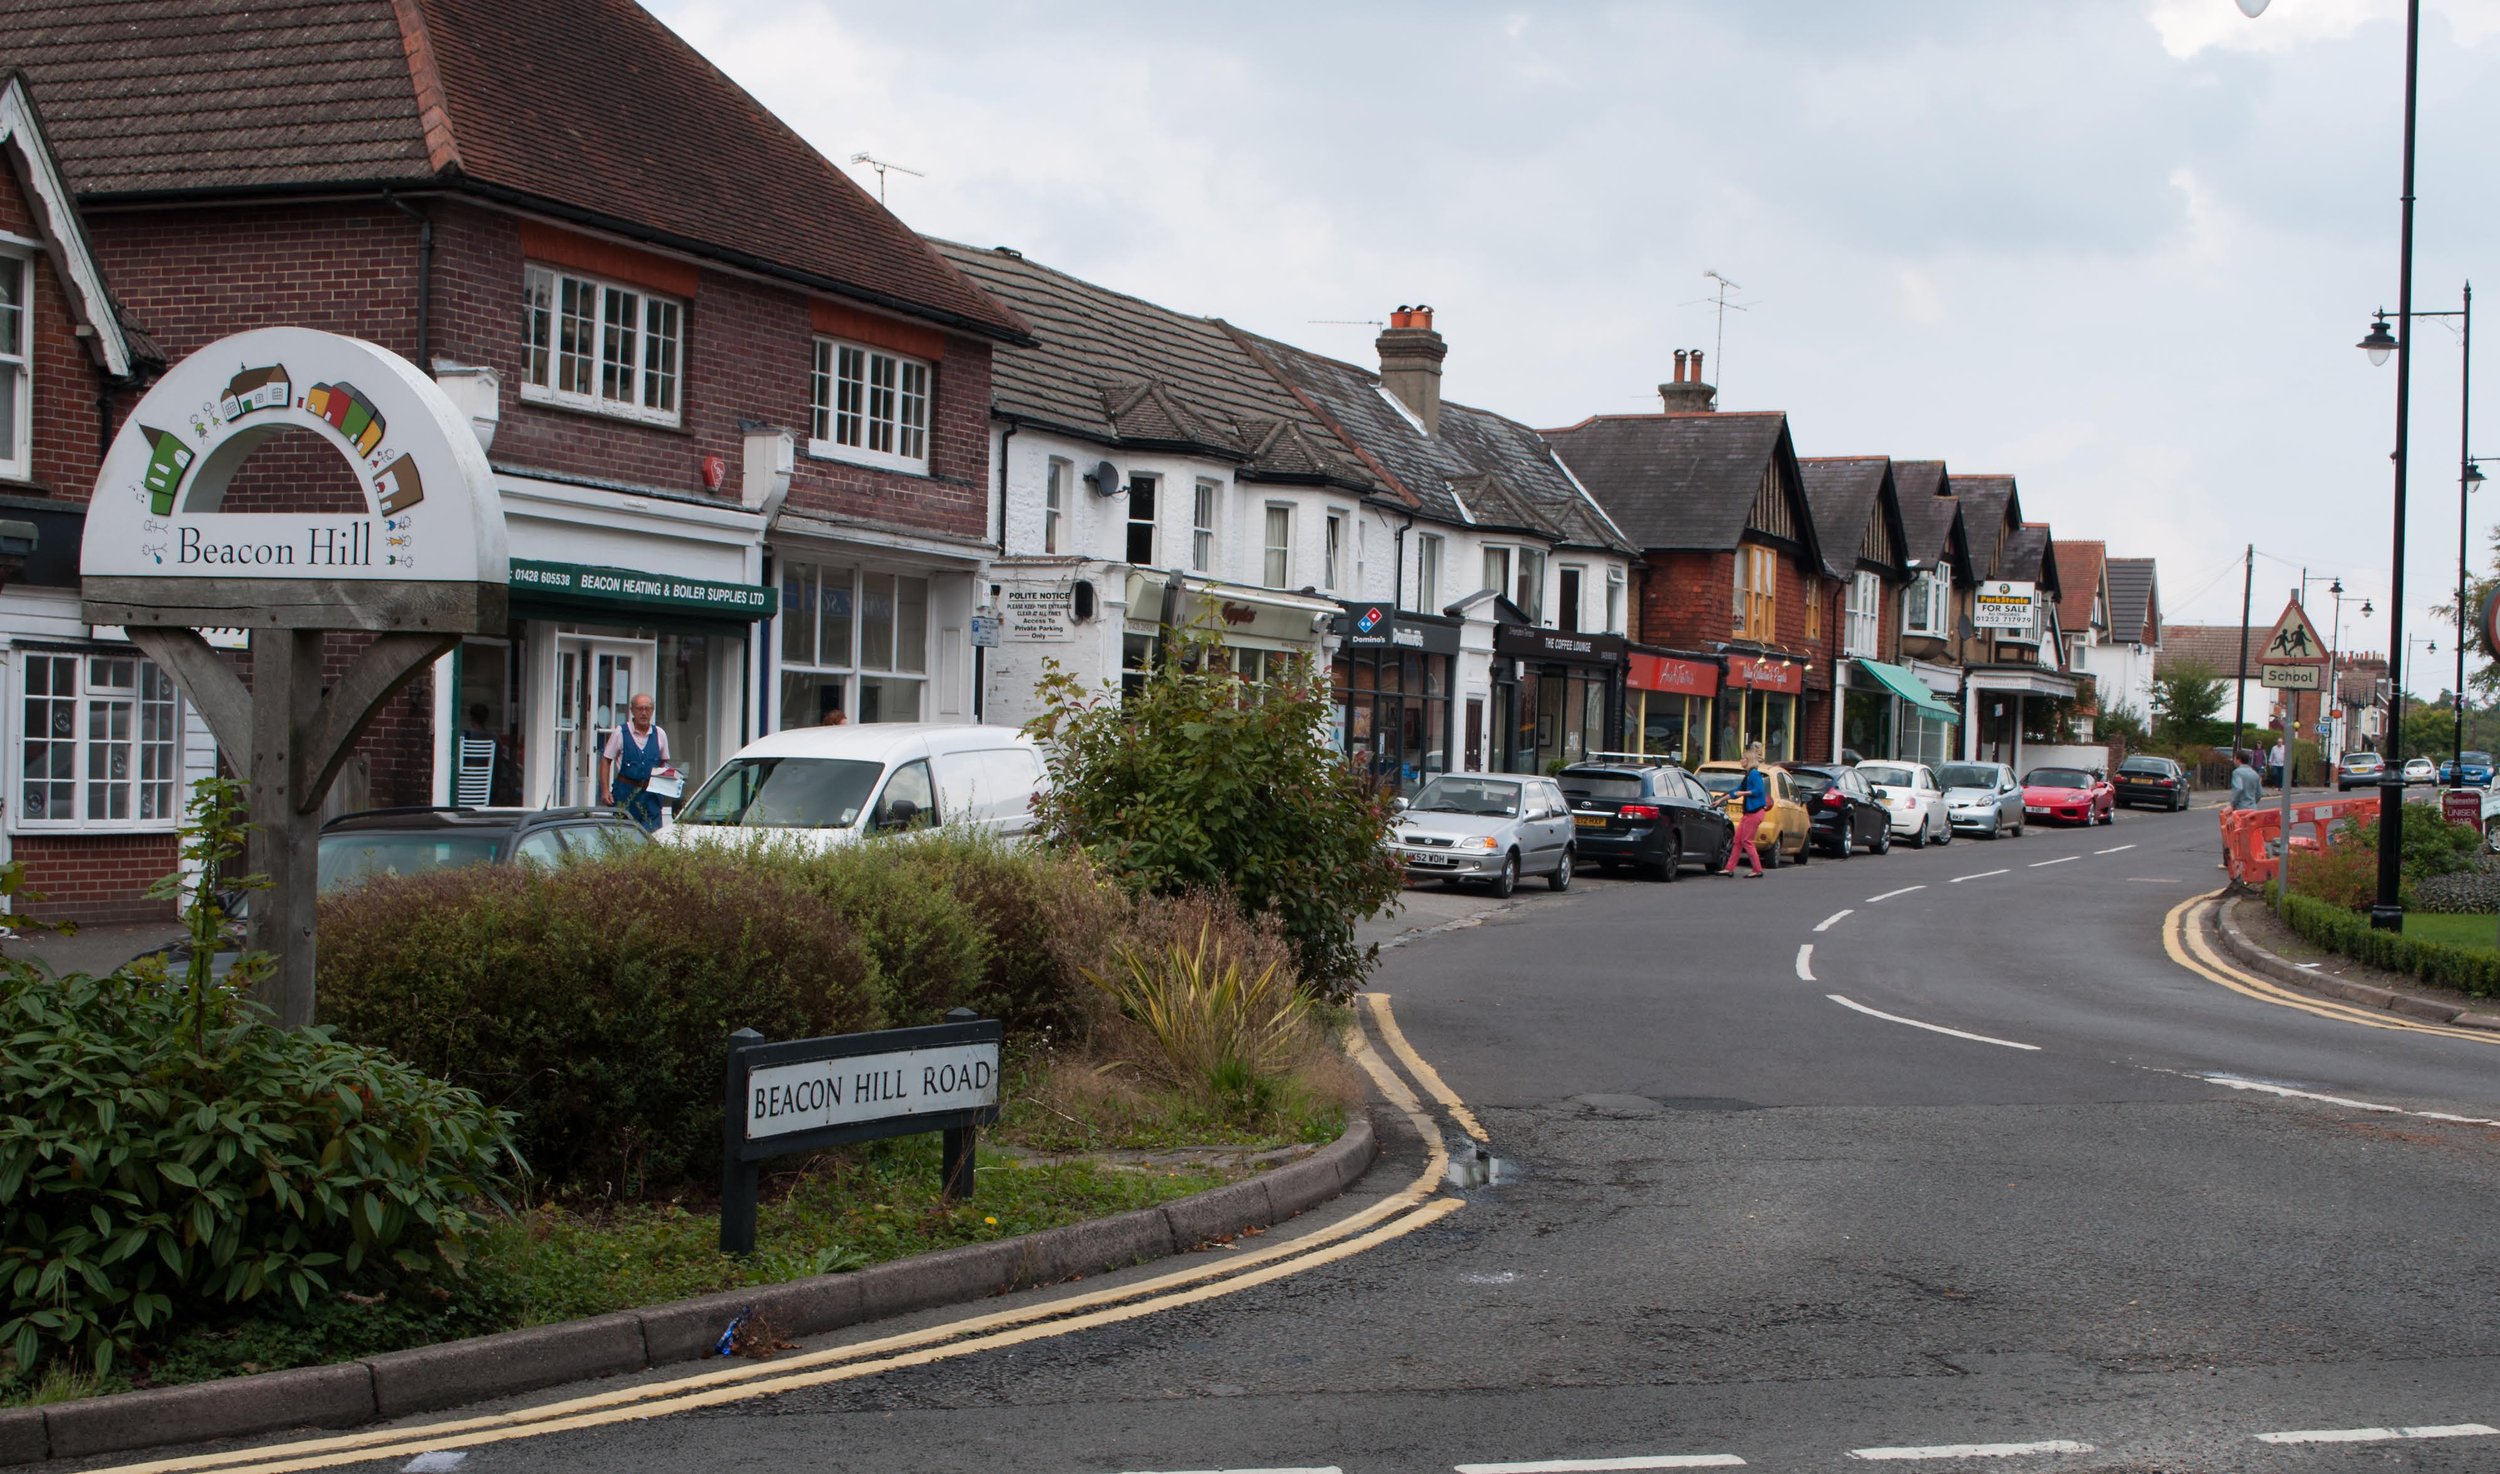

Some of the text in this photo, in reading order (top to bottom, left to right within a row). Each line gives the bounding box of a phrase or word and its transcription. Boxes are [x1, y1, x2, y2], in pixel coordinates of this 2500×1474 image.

[177, 521, 372, 566] Beacon Hill
[515, 568, 539, 582] 01428
[541, 571, 571, 586] 605538
[581, 574, 620, 592] BEACON
[623, 579, 661, 596] HEATING
[663, 584, 671, 597] &
[673, 585, 705, 599] BOILER
[707, 588, 748, 604] SUPPLIES
[749, 592, 765, 606] LTD
[1009, 592, 1070, 600] POLITE NOTICE
[2005, 605, 2028, 613] SALE
[1039, 625, 1064, 633] Parking
[1352, 635, 1386, 644] Domino's
[1545, 637, 1592, 653] THE COFFEE LOUNGE
[2268, 670, 2313, 682] School
[2447, 808, 2477, 817] UNISEX
[754, 1061, 991, 1119] BEACON HILL ROAD
